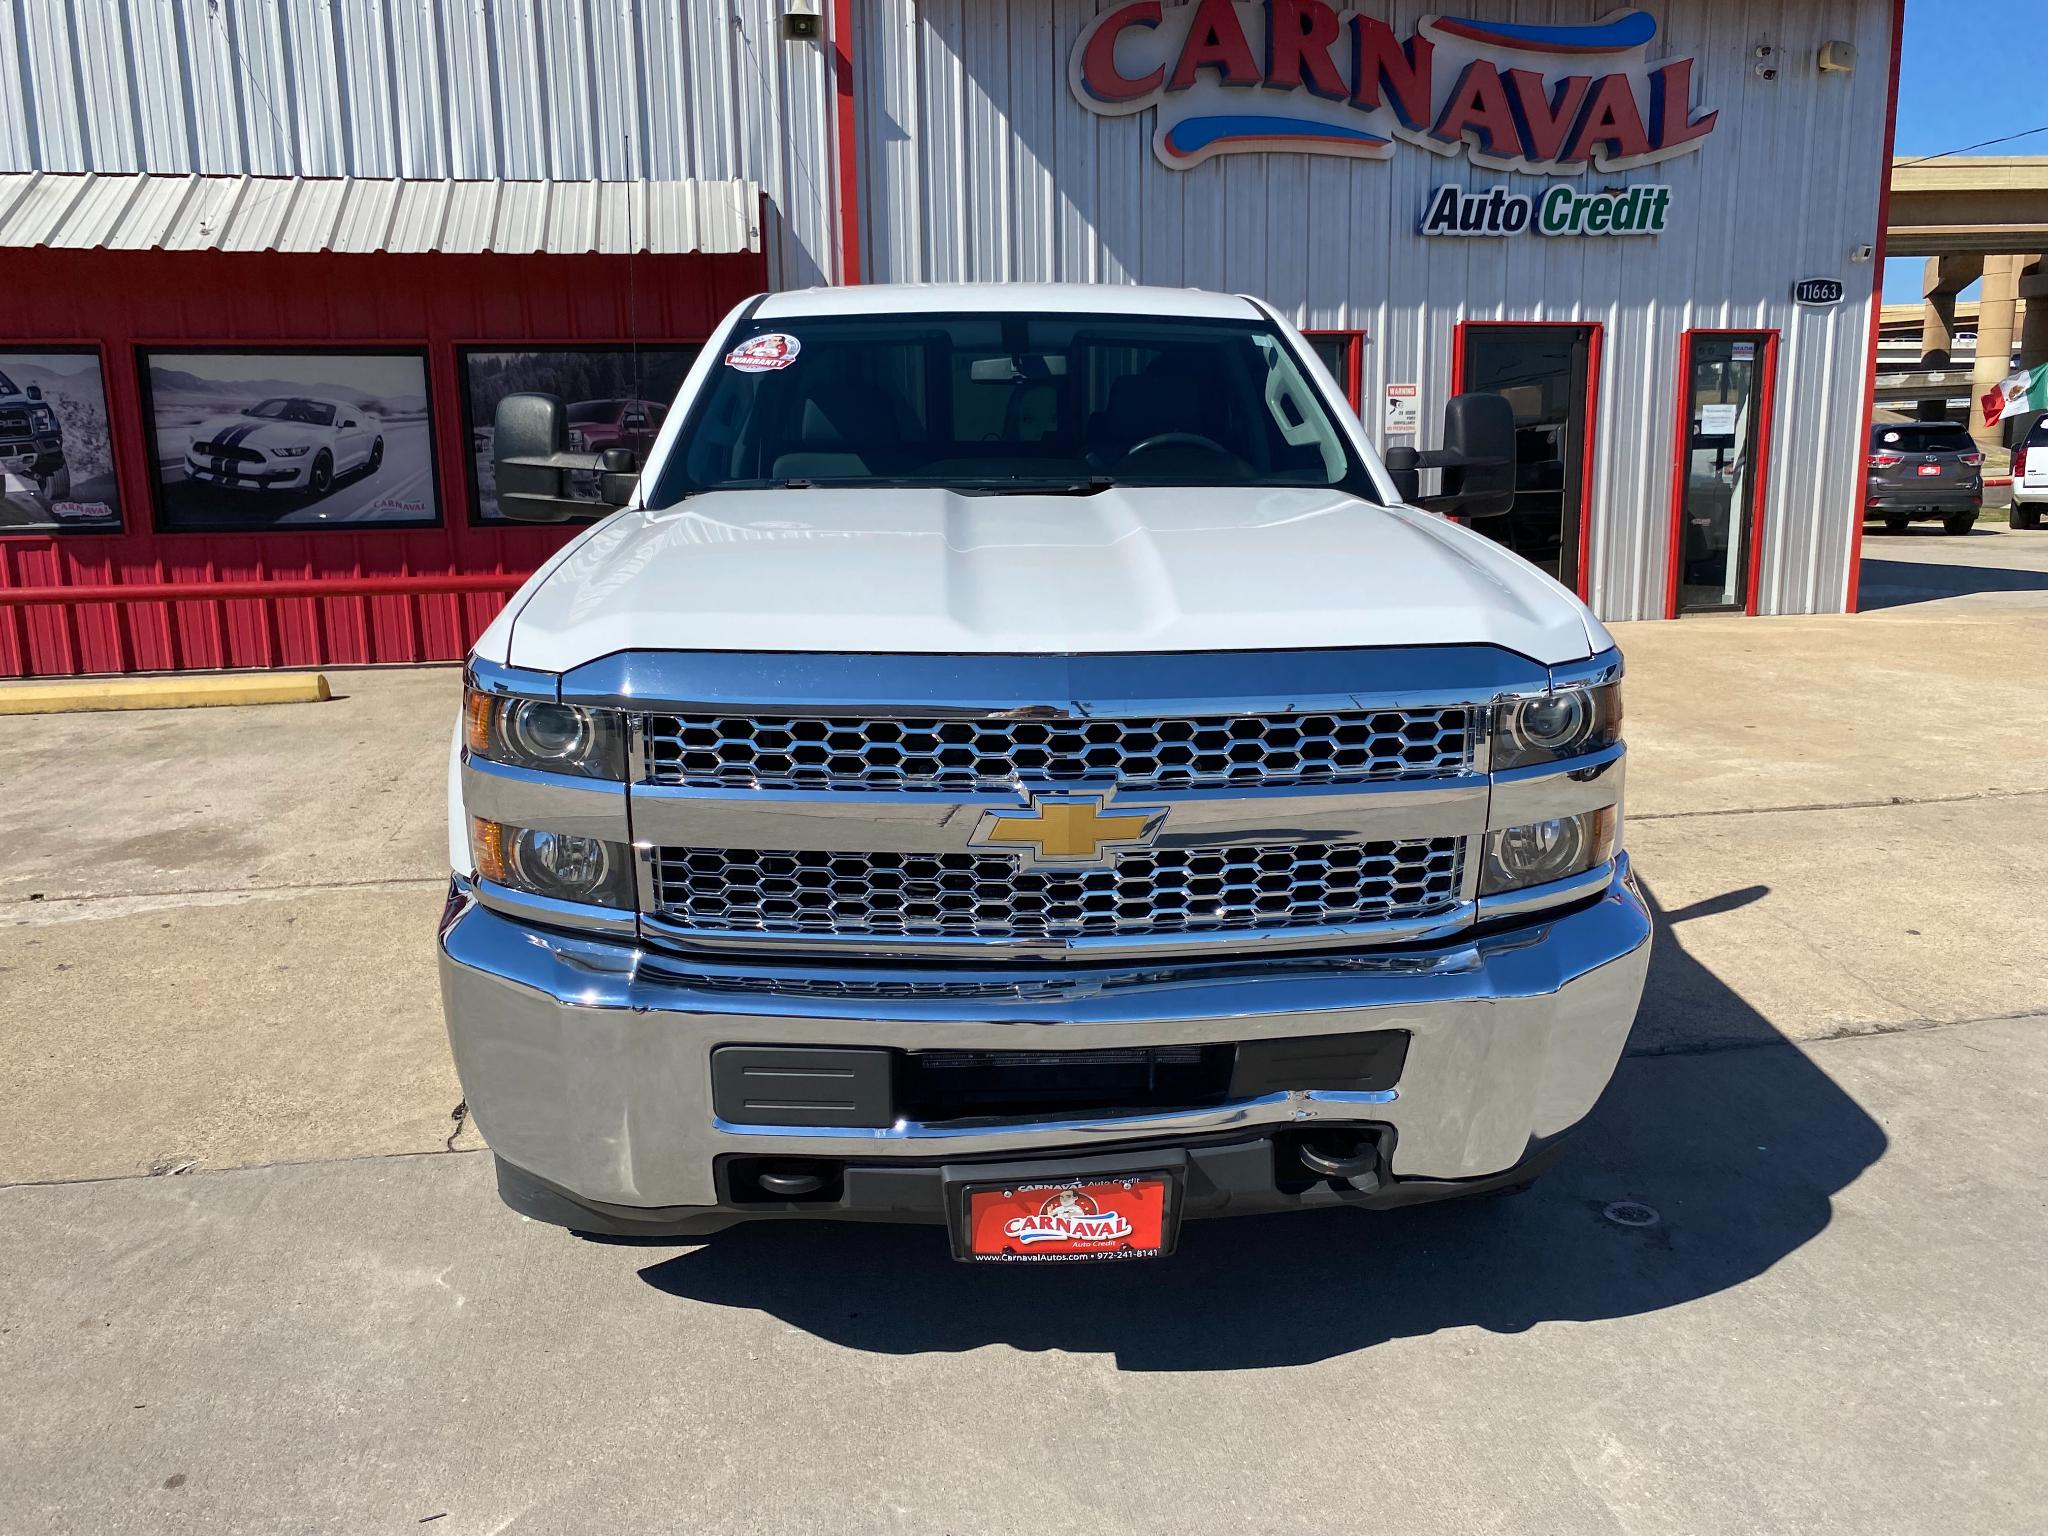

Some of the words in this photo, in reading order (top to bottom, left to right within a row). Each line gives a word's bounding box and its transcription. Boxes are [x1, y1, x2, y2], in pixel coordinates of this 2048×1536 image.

[1081, 0, 1719, 164] CARNAVAL
[1427, 185, 1529, 232] Auto
[1541, 185, 1671, 232] Credit
[1802, 284, 1837, 299] 11663
[730, 356, 785, 366] WARRANTY
[1389, 387, 1415, 396] WARNING
[53, 502, 112, 516] CARNAVAL
[373, 499, 425, 512] CARNAVAL
[1018, 1182, 1085, 1193] CARNAVAL
[1087, 1180, 1111, 1188] Auto
[1112, 1177, 1140, 1186] Credit
[1004, 1215, 1130, 1239] CARNAVAL
[975, 1252, 1088, 1262] www.CarnavalAutos.com
[1097, 1249, 1158, 1260] 972-241-8141
